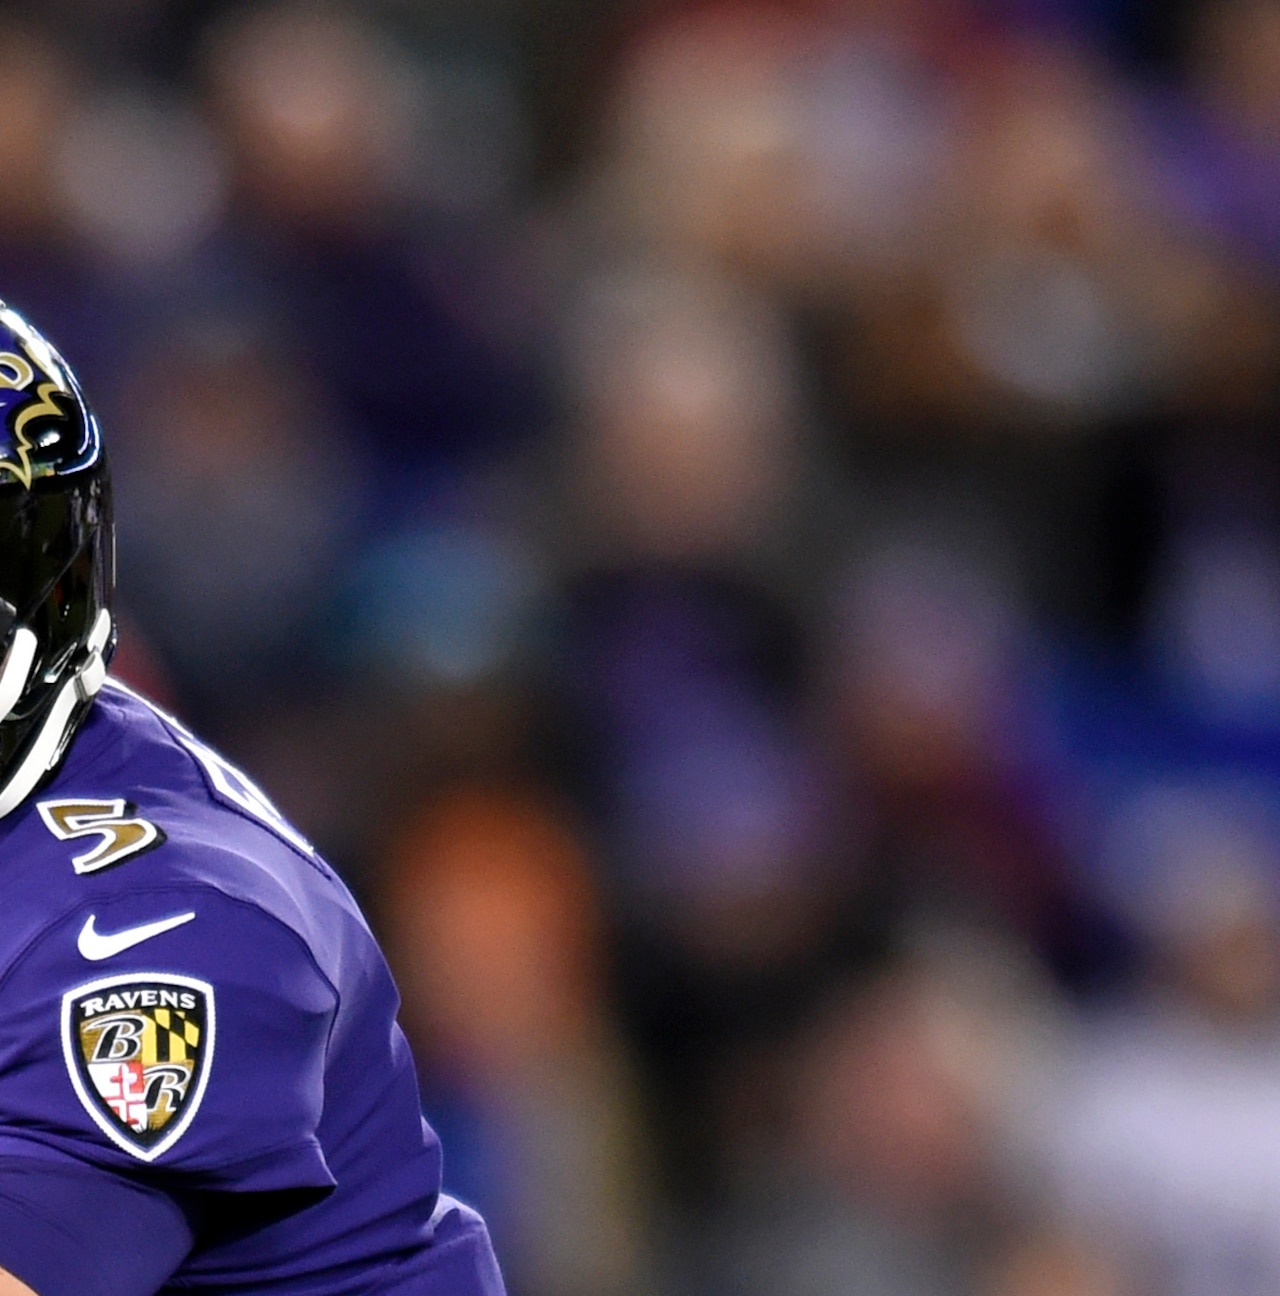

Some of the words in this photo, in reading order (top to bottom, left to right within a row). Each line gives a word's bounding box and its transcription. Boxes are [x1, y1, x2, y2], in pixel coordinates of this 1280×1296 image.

[36, 798, 160, 874] 5
[80, 990, 196, 1017] RAVENS
[83, 1014, 144, 1062] B
[143, 1064, 192, 1112] R
